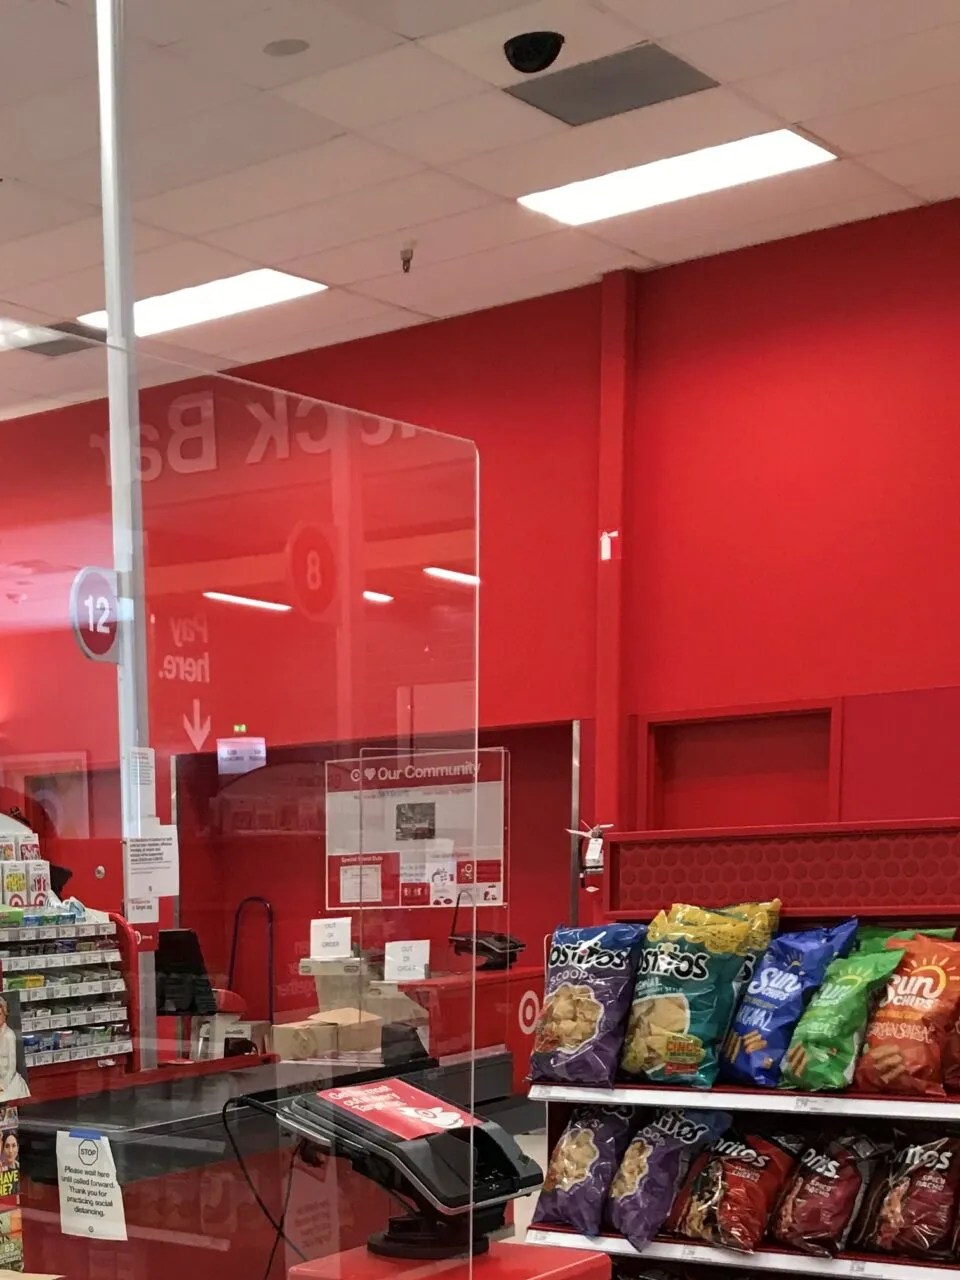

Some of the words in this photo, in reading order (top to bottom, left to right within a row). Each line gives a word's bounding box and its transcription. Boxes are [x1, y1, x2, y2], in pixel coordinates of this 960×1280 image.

[84, 594, 111, 634] 12
[377, 766, 402, 781] Our
[404, 760, 481, 780] Community
[747, 967, 802, 994] Sun
[889, 995, 936, 1011] CHIPS
[80, 1147, 97, 1157] STOP
[64, 1165, 84, 1175] Please
[84, 1168, 97, 1176] wait
[97, 1170, 110, 1178] here
[61, 1175, 73, 1183] until
[73, 1177, 90, 1187] called
[90, 1179, 115, 1189] forward.
[69, 1185, 86, 1195] Thank
[87, 1188, 98, 1197] you
[66, 1195, 95, 1207] practicing
[94, 1199, 113, 1207] social
[73, 1205, 105, 1218] distancing.
[3, 1243, 15, 1253] 63
